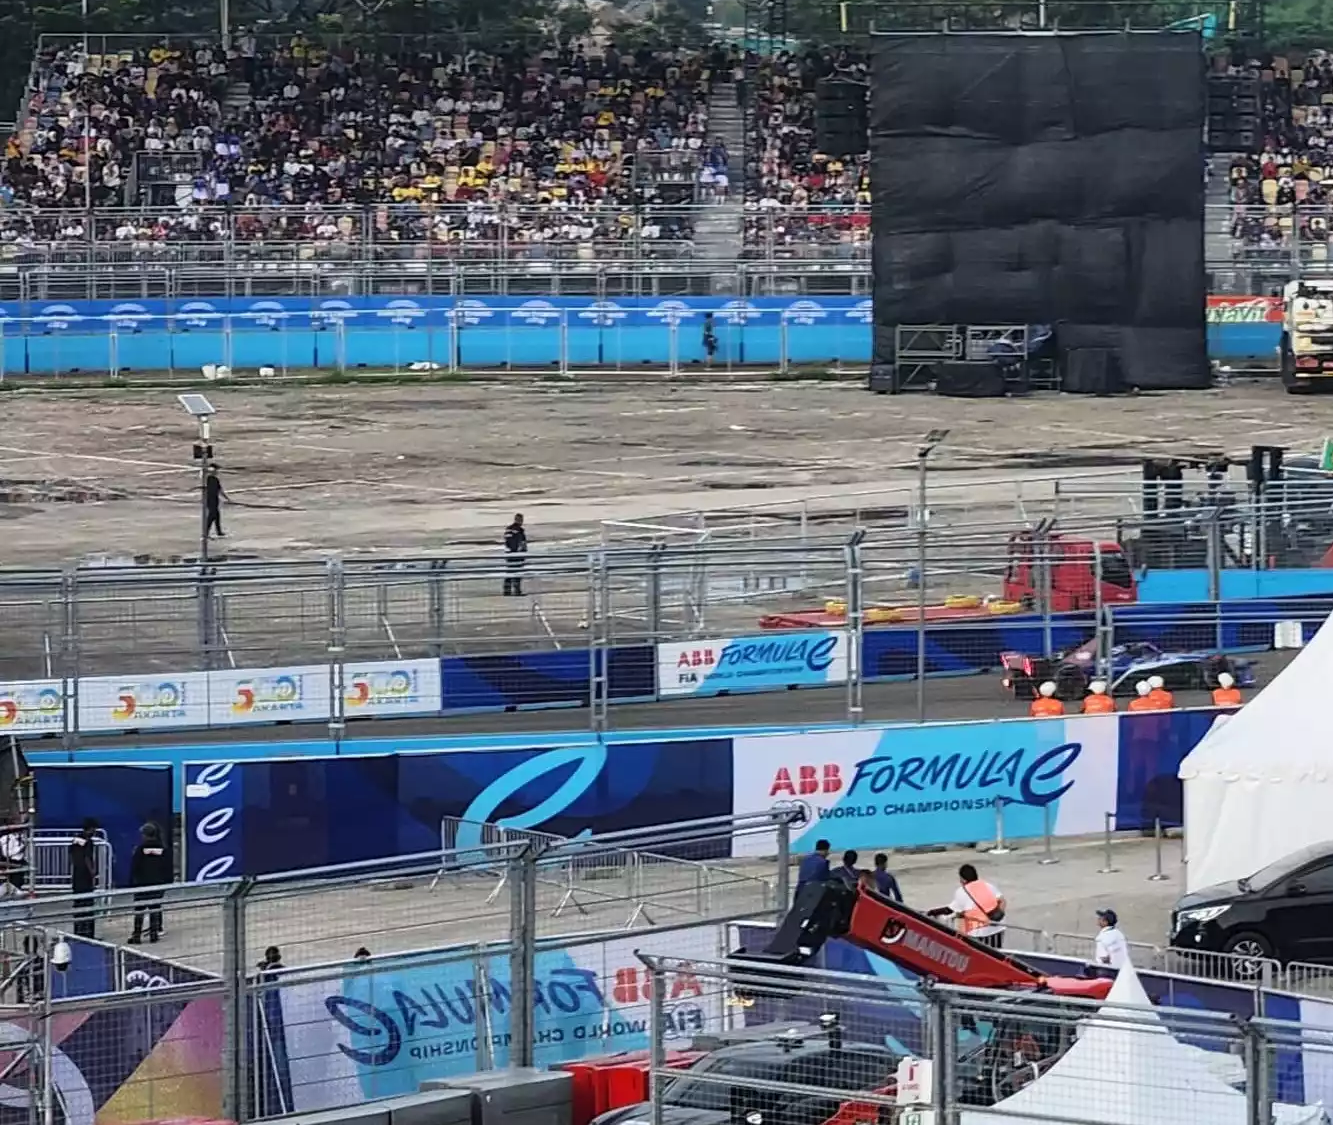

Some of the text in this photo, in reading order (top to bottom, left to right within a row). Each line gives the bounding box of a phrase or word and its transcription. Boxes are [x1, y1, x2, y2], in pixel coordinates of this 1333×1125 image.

[677, 649, 715, 668] ABB
[716, 640, 809, 669] FORMULA
[770, 763, 844, 796] ABB
[847, 747, 1025, 797] FORMULA
[818, 804, 877, 820] WORLD
